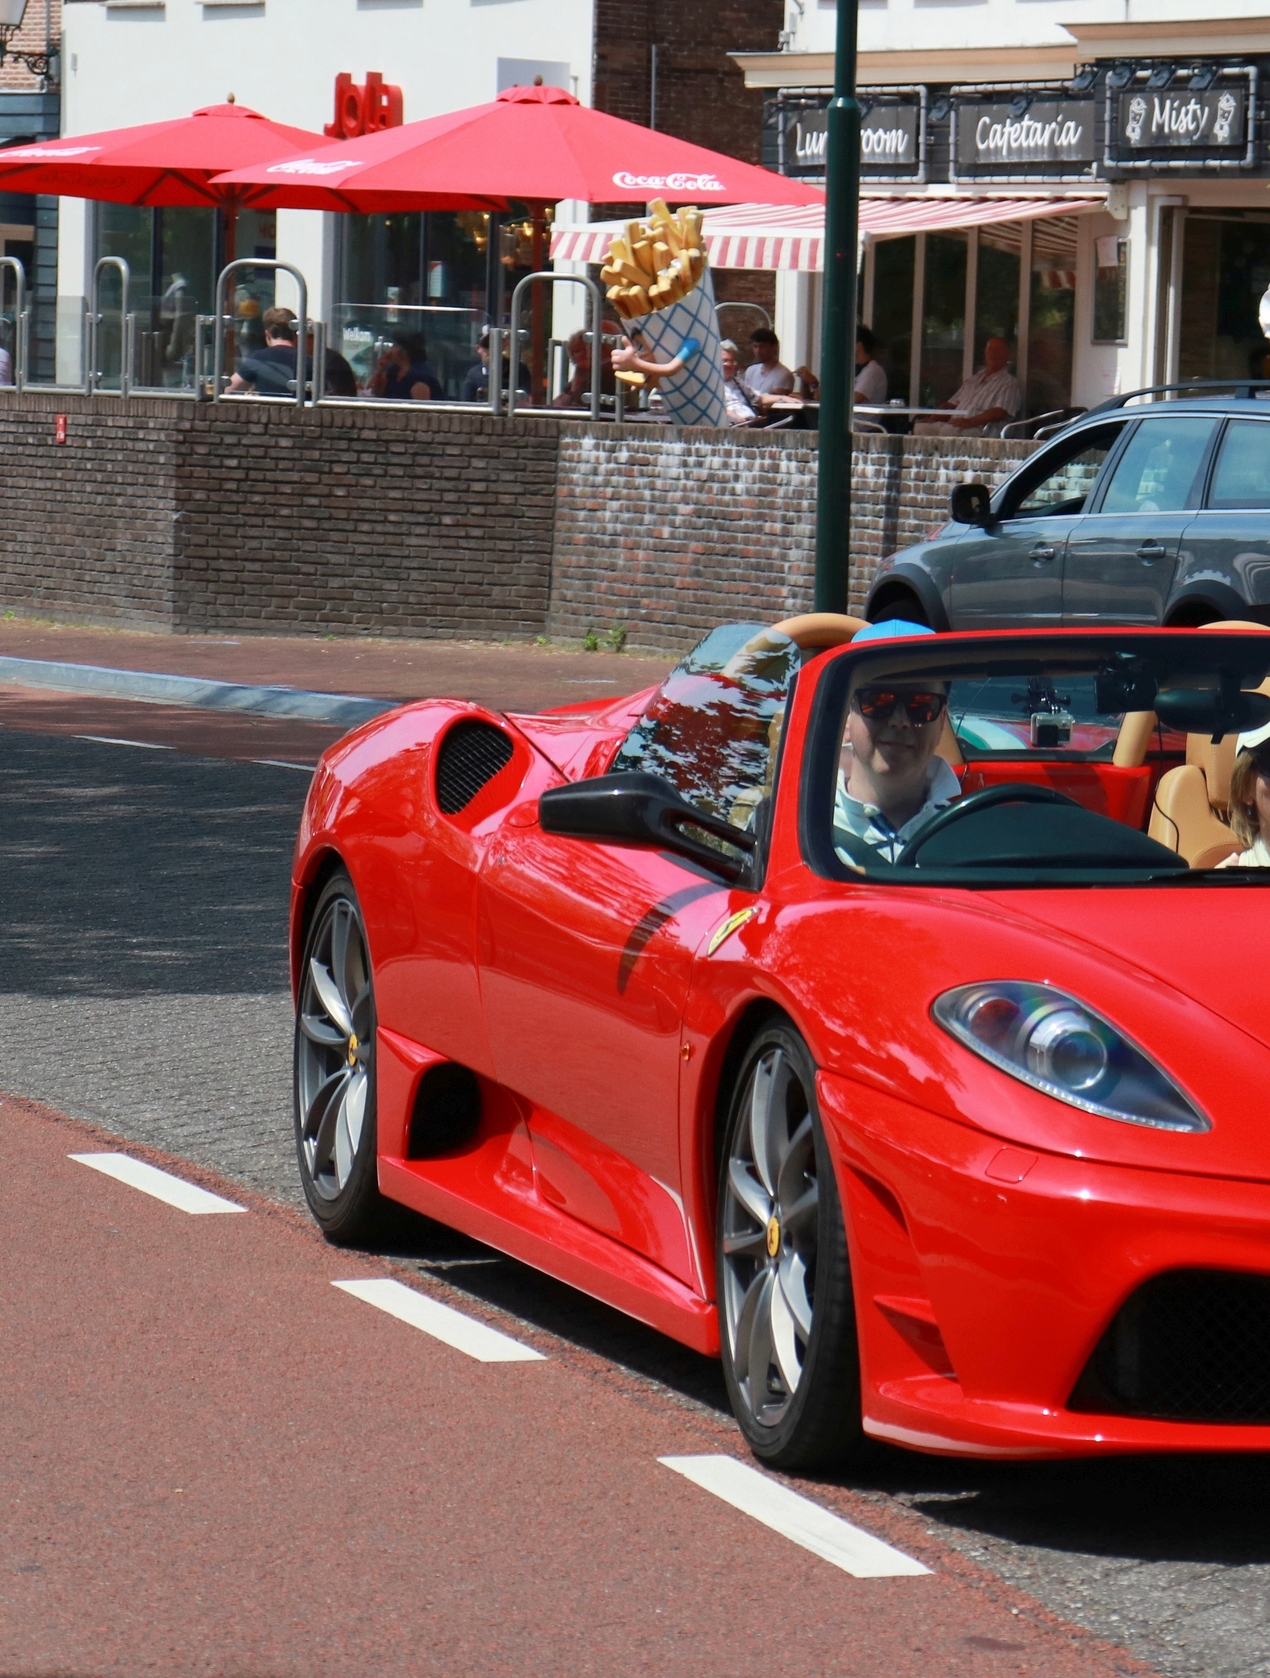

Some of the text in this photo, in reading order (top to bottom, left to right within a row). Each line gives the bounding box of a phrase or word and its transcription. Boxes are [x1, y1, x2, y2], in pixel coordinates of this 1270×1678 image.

[976, 113, 1083, 156] Cafetaria
[1151, 97, 1209, 140] Misty
[612, 171, 726, 190] Coca-Cola
